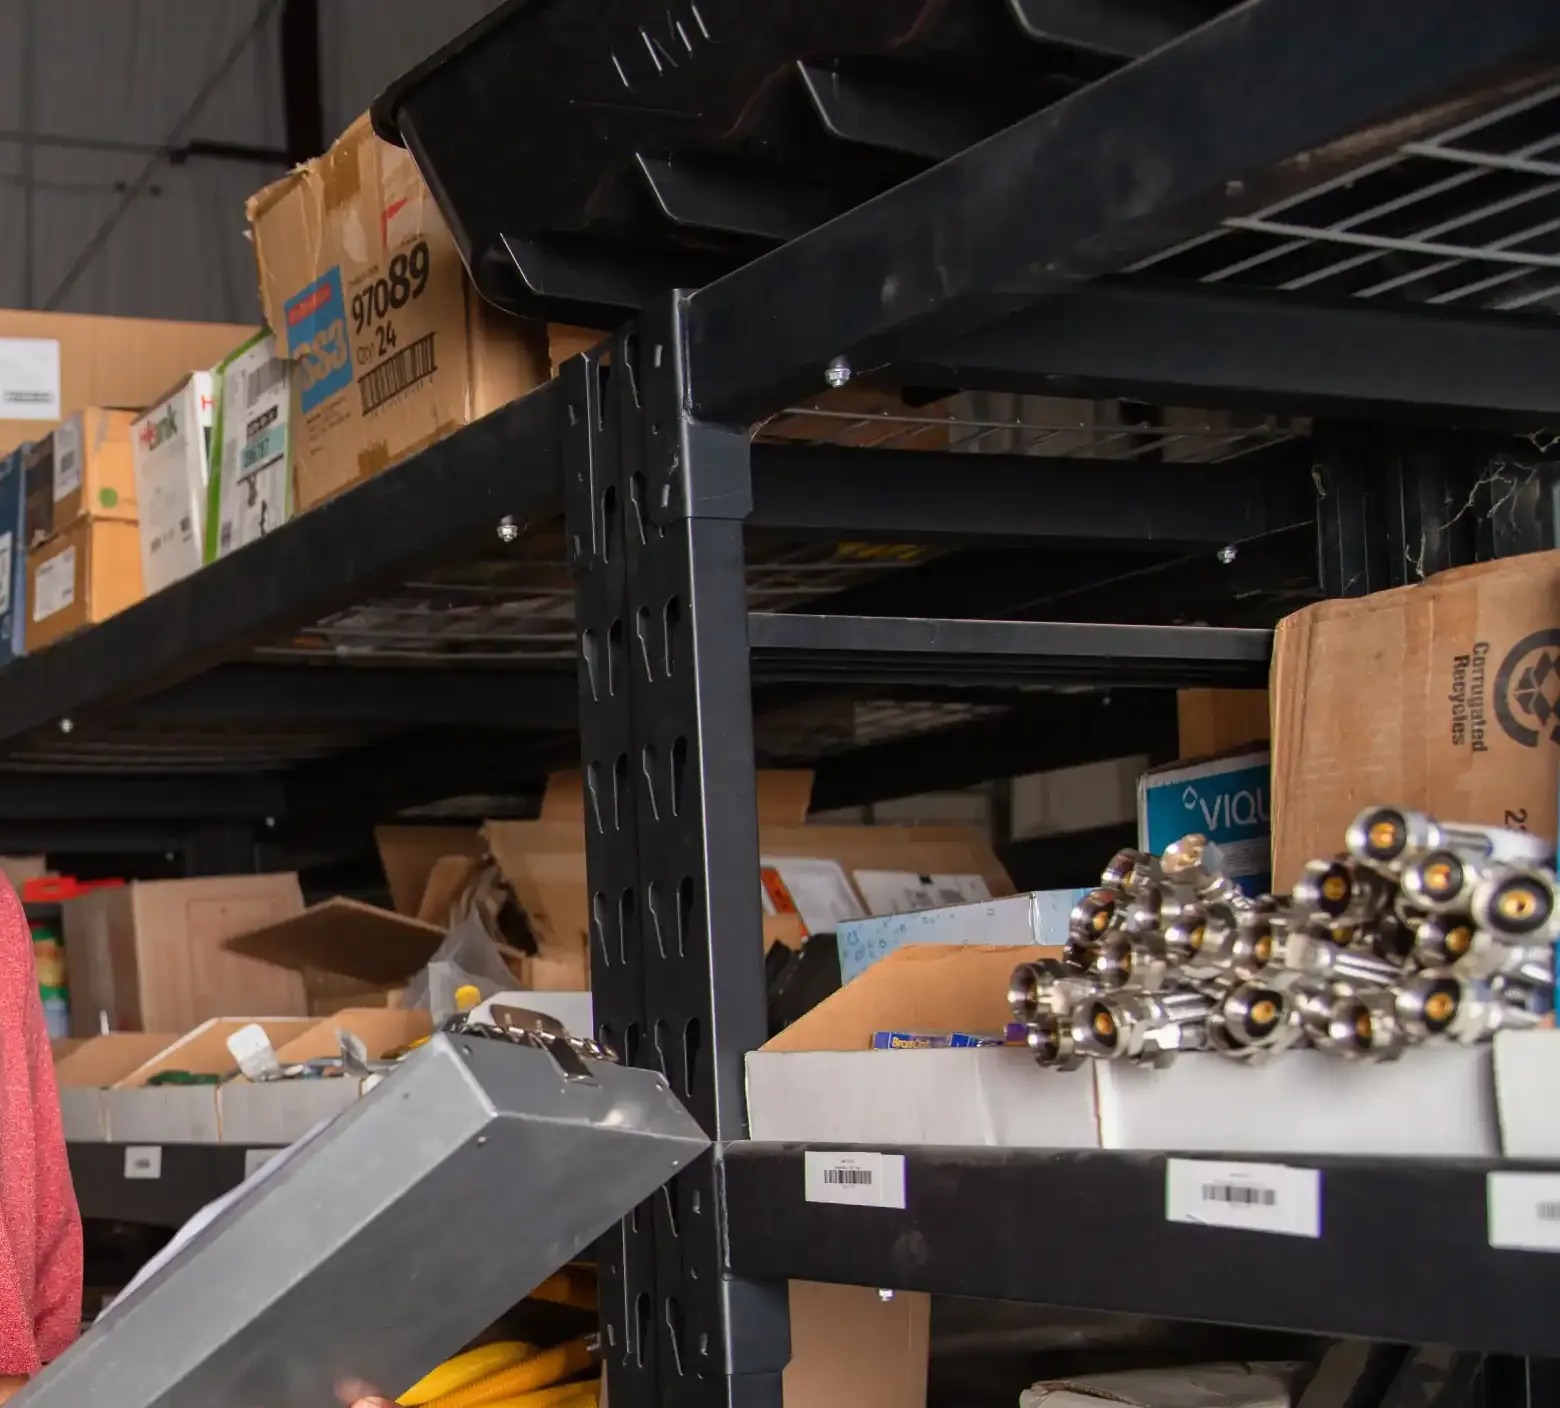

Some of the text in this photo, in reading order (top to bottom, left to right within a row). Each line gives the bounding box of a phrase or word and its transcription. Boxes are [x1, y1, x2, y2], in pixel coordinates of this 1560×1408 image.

[351, 240, 430, 336] 97089
[375, 321, 397, 357] 24
[1448, 655, 1470, 746] Recycles
[1471, 642, 1490, 753] Corrugated
